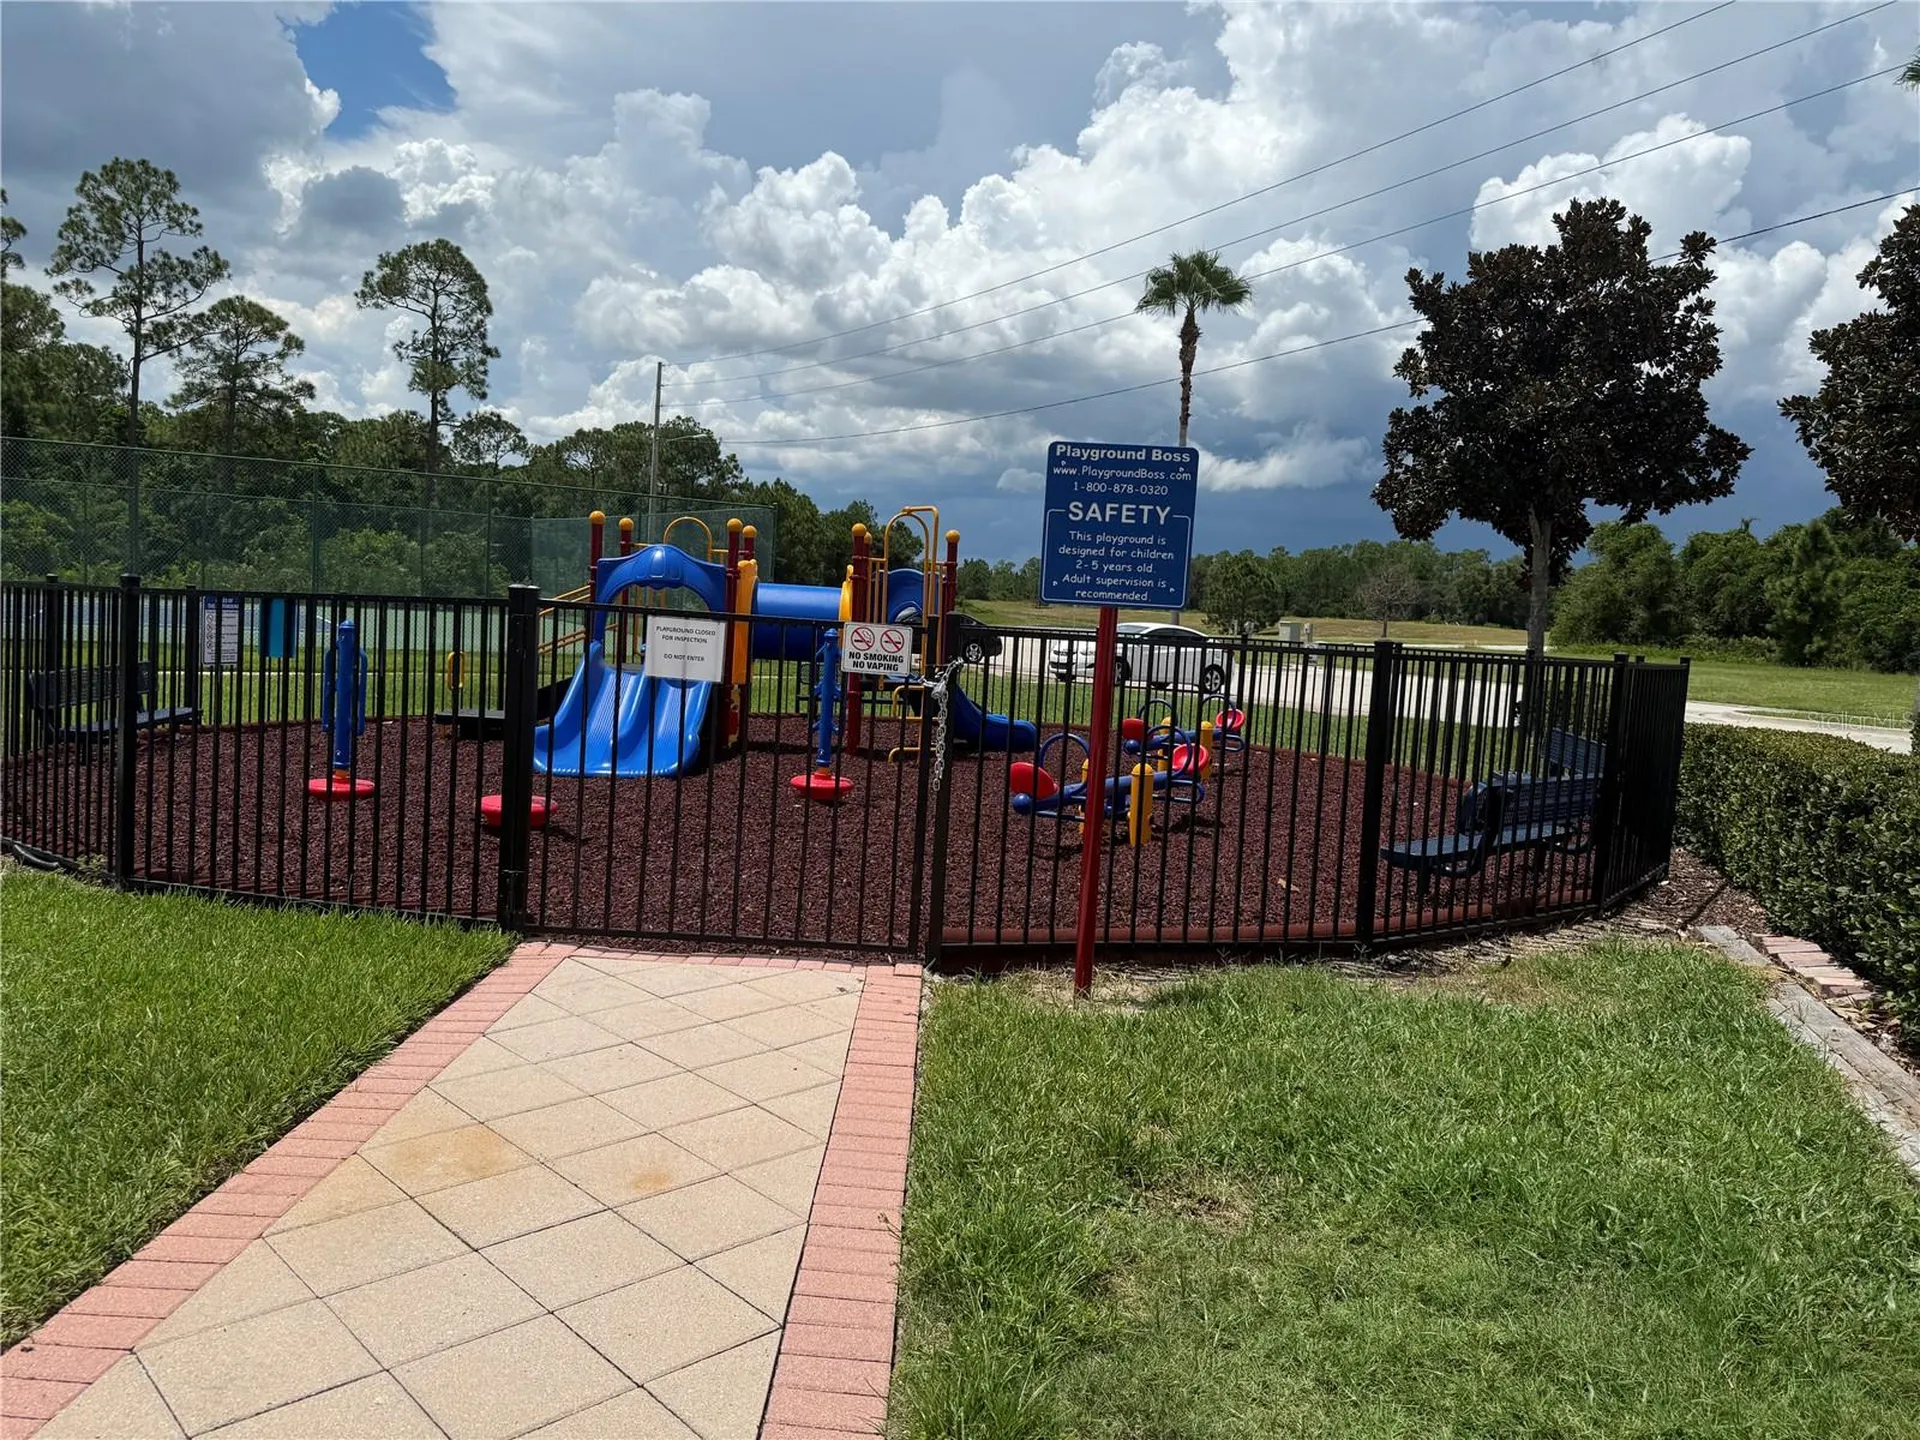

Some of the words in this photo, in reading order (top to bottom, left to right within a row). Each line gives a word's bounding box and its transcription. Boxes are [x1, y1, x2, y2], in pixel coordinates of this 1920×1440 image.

[1056, 445, 1145, 461] Playground
[1152, 449, 1191, 462] Boss
[1074, 482, 1168, 495] 1-800-878-0320
[1068, 502, 1170, 525] SAFETY
[1069, 531, 1091, 541] This
[1096, 533, 1153, 545] playground
[1158, 536, 1166, 545] is
[1058, 545, 1104, 558] designed
[1110, 547, 1127, 557] for
[1131, 549, 1174, 559] children
[1103, 563, 1132, 572] years
[1062, 574, 1091, 583] Adult
[1096, 576, 1153, 587] supervision
[1158, 579, 1166, 588] is
[656, 626, 693, 634] PLAYGROUND
[849, 651, 861, 659] NO
[864, 653, 903, 663] SMOKING
[867, 662, 898, 671] VAPING
